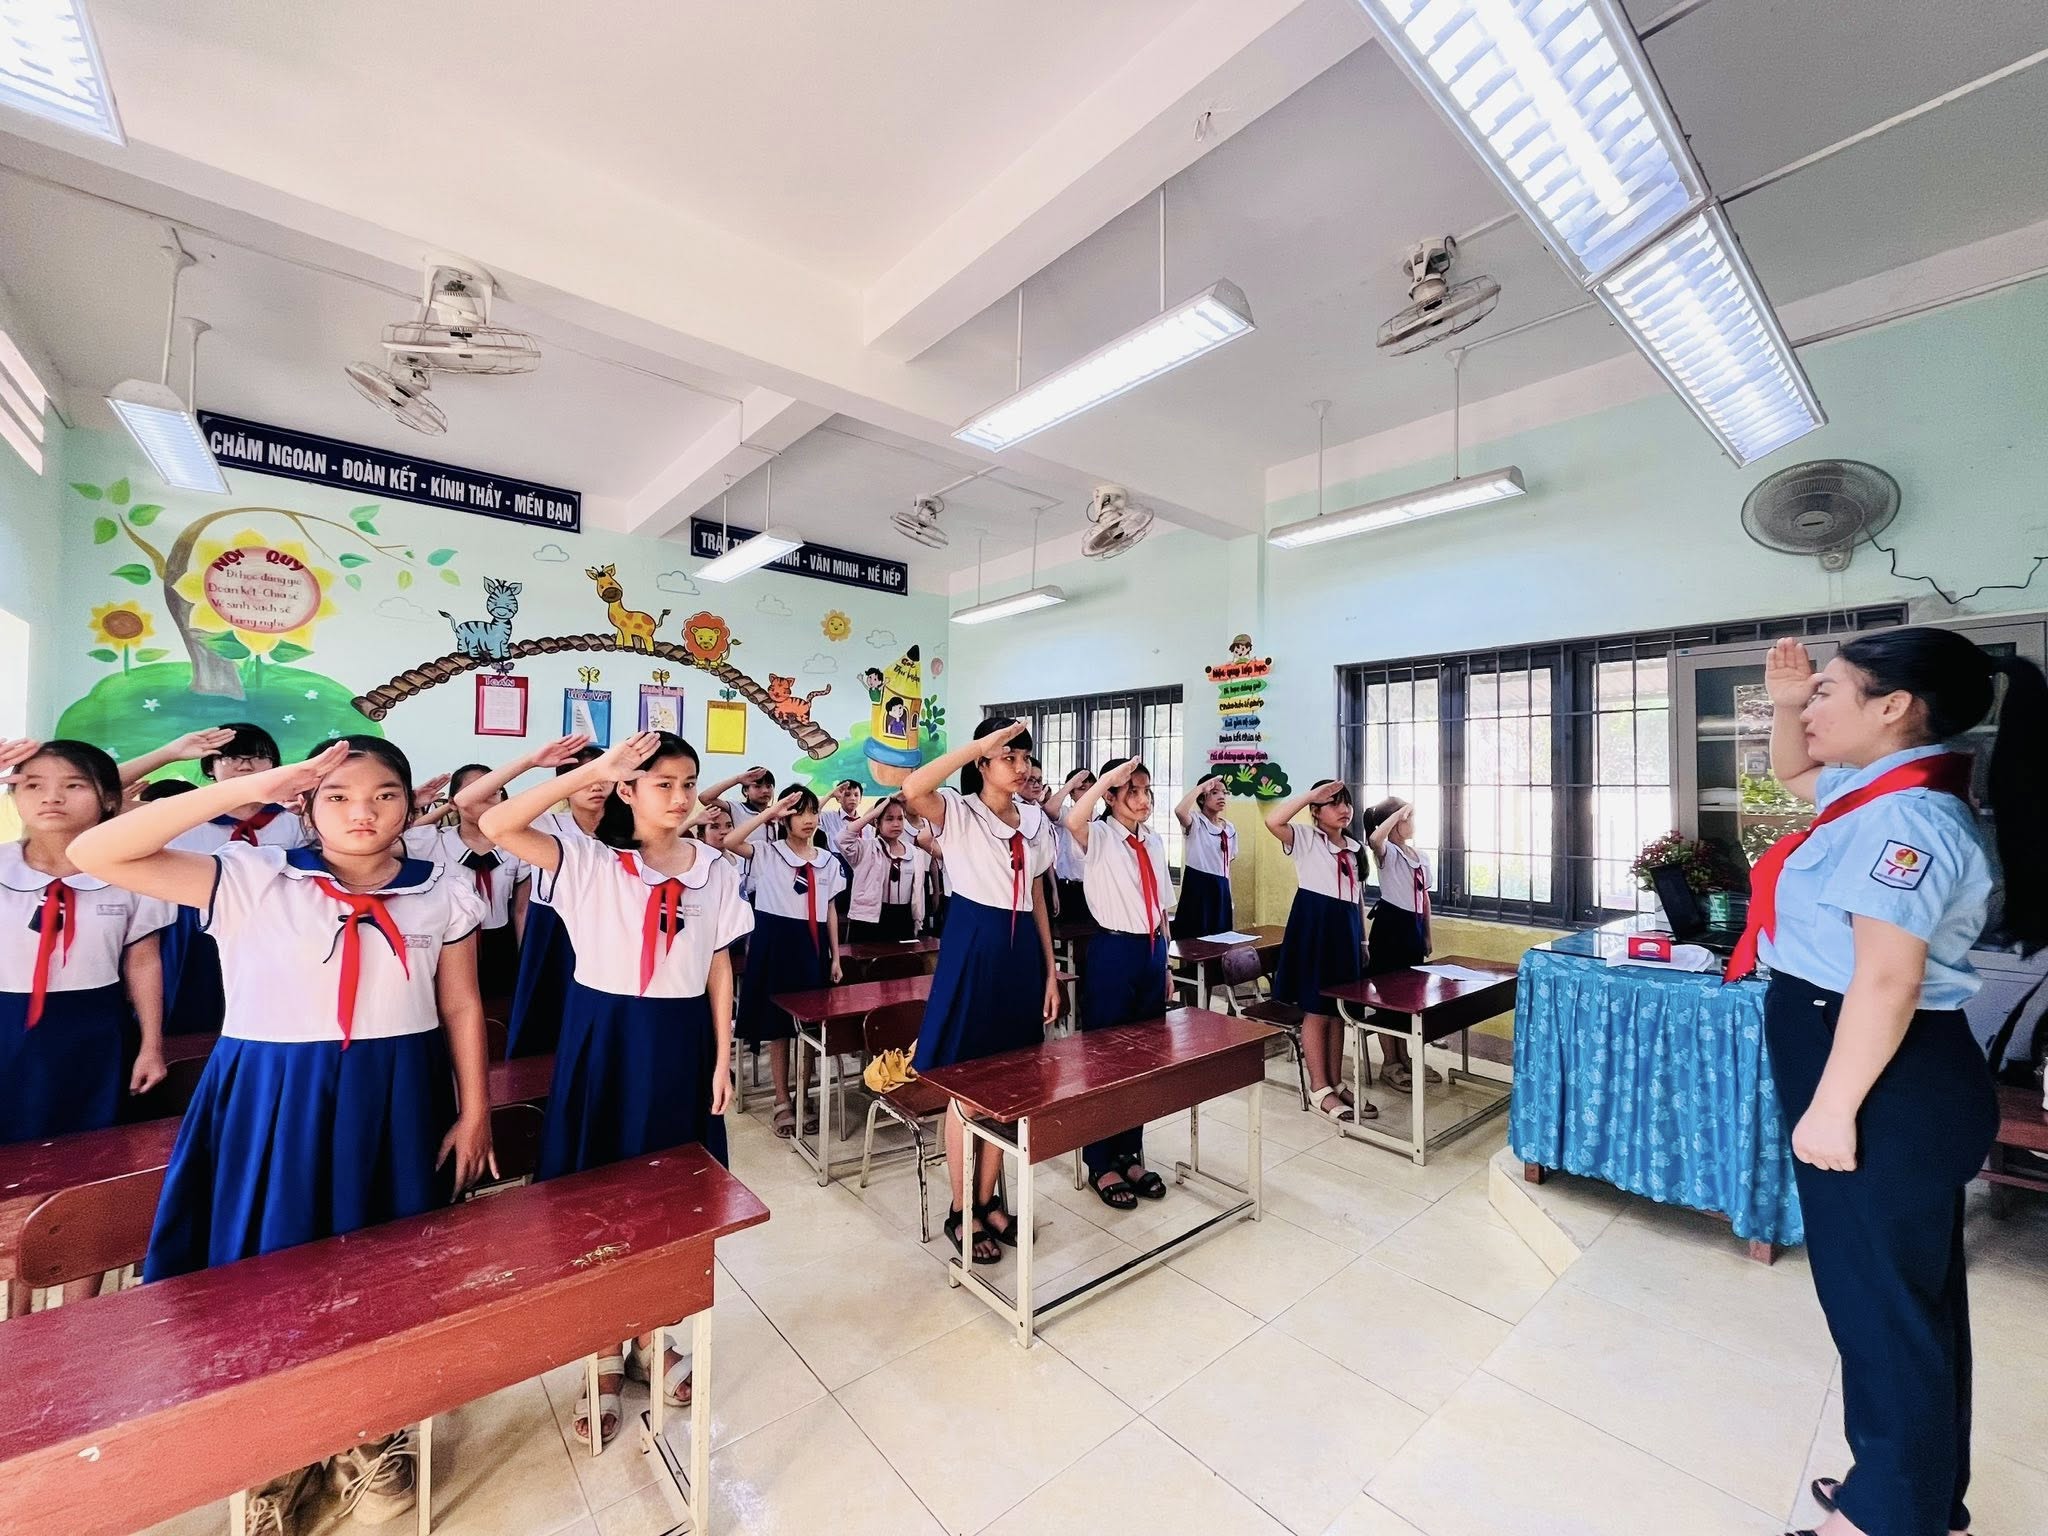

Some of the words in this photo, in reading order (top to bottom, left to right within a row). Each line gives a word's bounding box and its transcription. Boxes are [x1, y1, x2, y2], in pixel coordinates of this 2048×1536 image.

[210, 431, 263, 462] CHĂM
[268, 442, 327, 475] NGOAN
[342, 458, 386, 488] ĐOÀN
[389, 465, 417, 492] KẾT
[430, 474, 465, 502] KÍNH
[468, 481, 502, 509] THẦY
[514, 491, 544, 517] MẾN
[546, 500, 572, 525] BẠN
[810, 553, 830, 573] VĂN
[833, 559, 859, 579] MINH
[882, 567, 901, 586] NẾP
